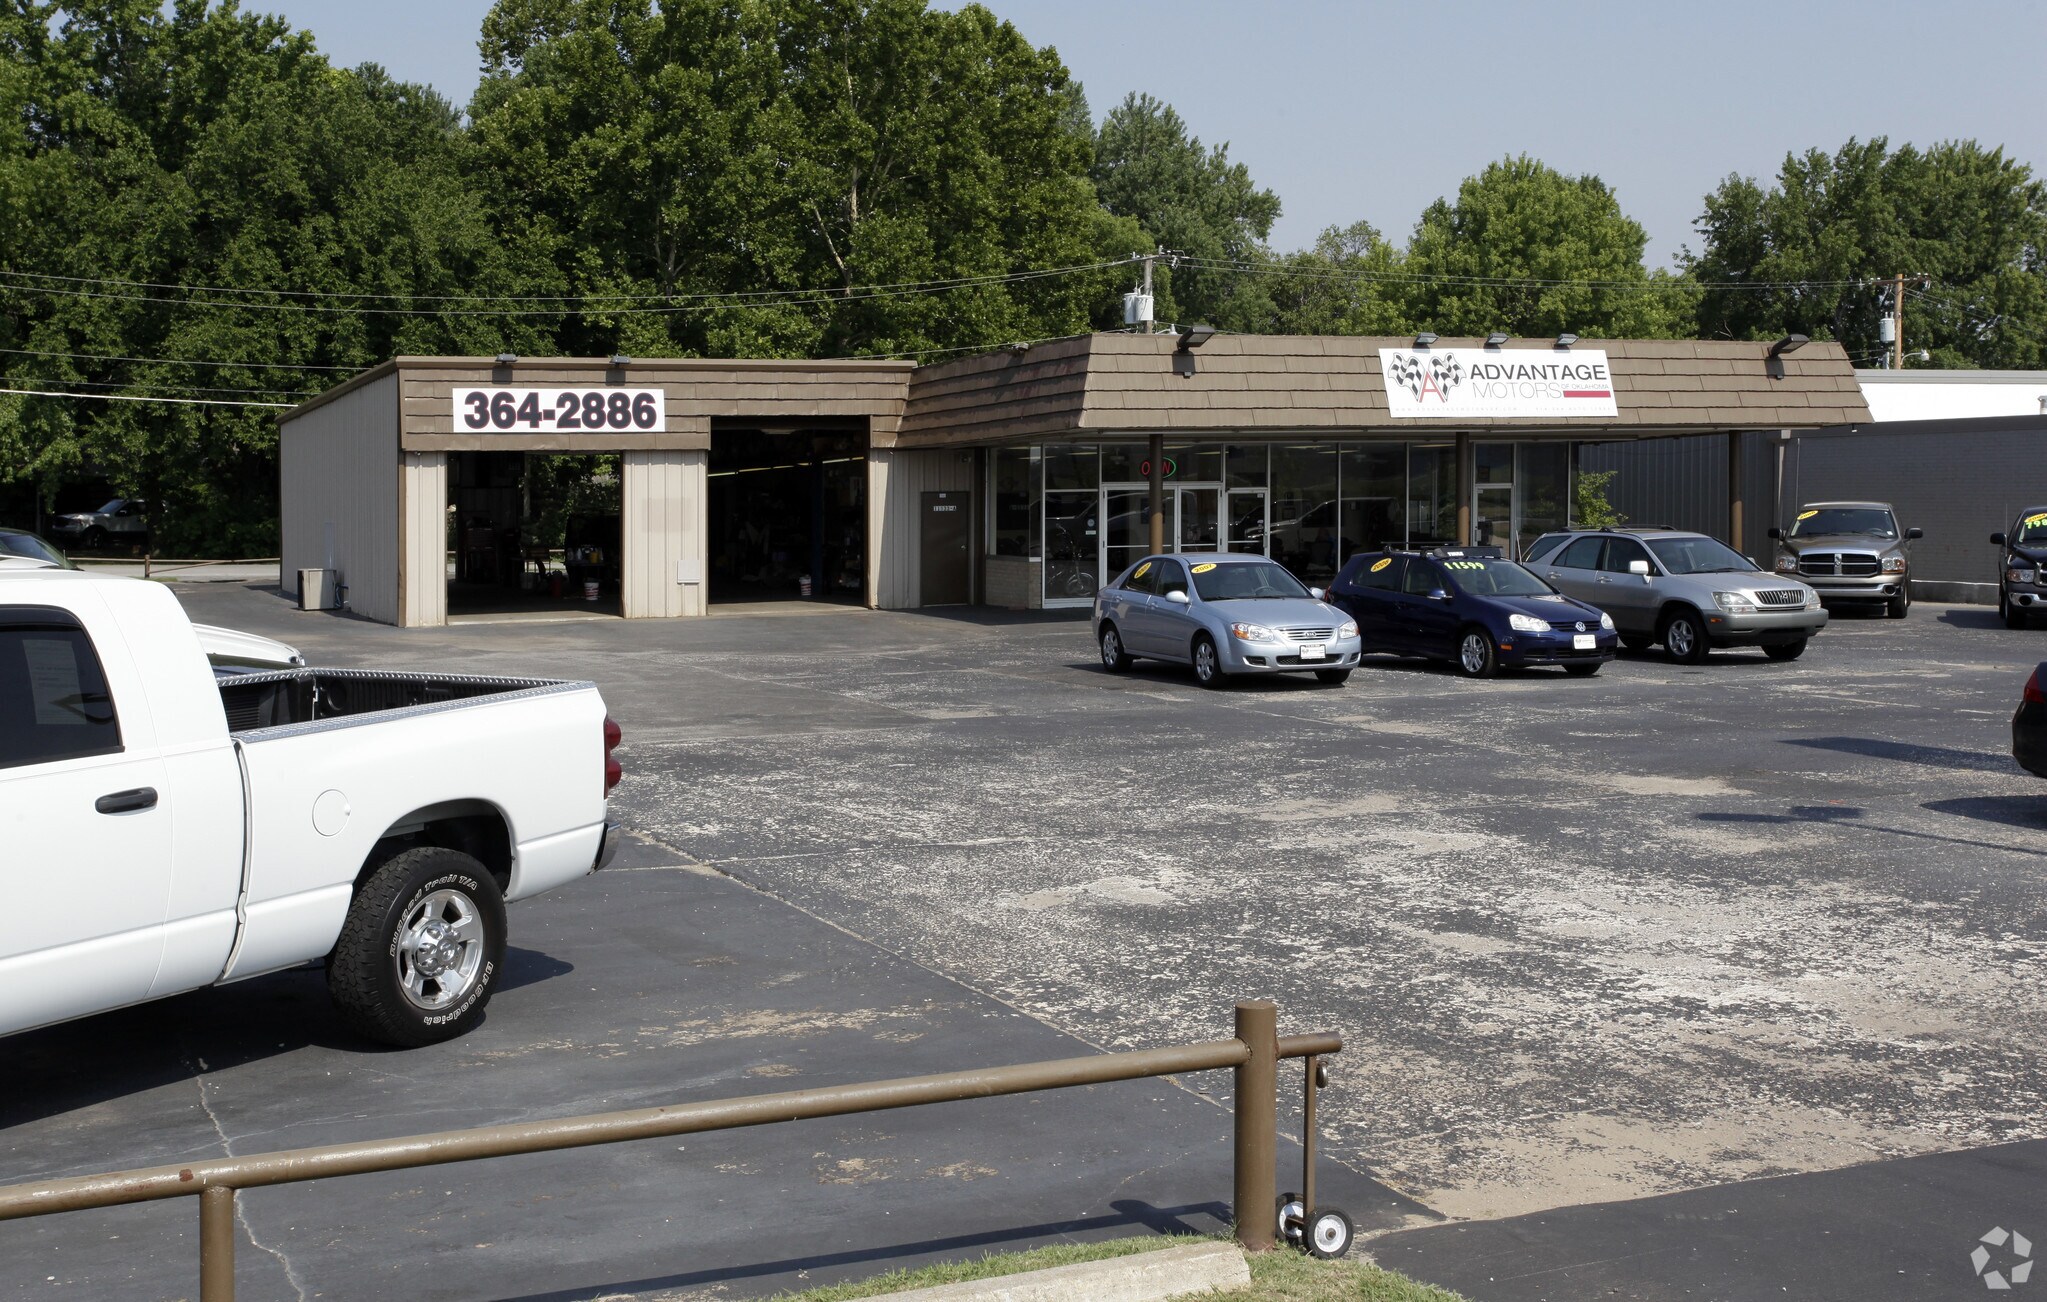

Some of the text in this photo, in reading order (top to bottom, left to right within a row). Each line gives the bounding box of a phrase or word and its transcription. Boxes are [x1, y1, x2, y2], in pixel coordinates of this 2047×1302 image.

[1470, 364, 1607, 380] ADVANTAGE
[1472, 382, 1562, 398] MOTORS
[464, 391, 657, 430] 364-2886
[1141, 461, 1171, 475] ON
[1443, 561, 1485, 570] 11599
[389, 874, 478, 957] Rugged Trail T/A
[424, 961, 494, 1026] BFGoodrich
